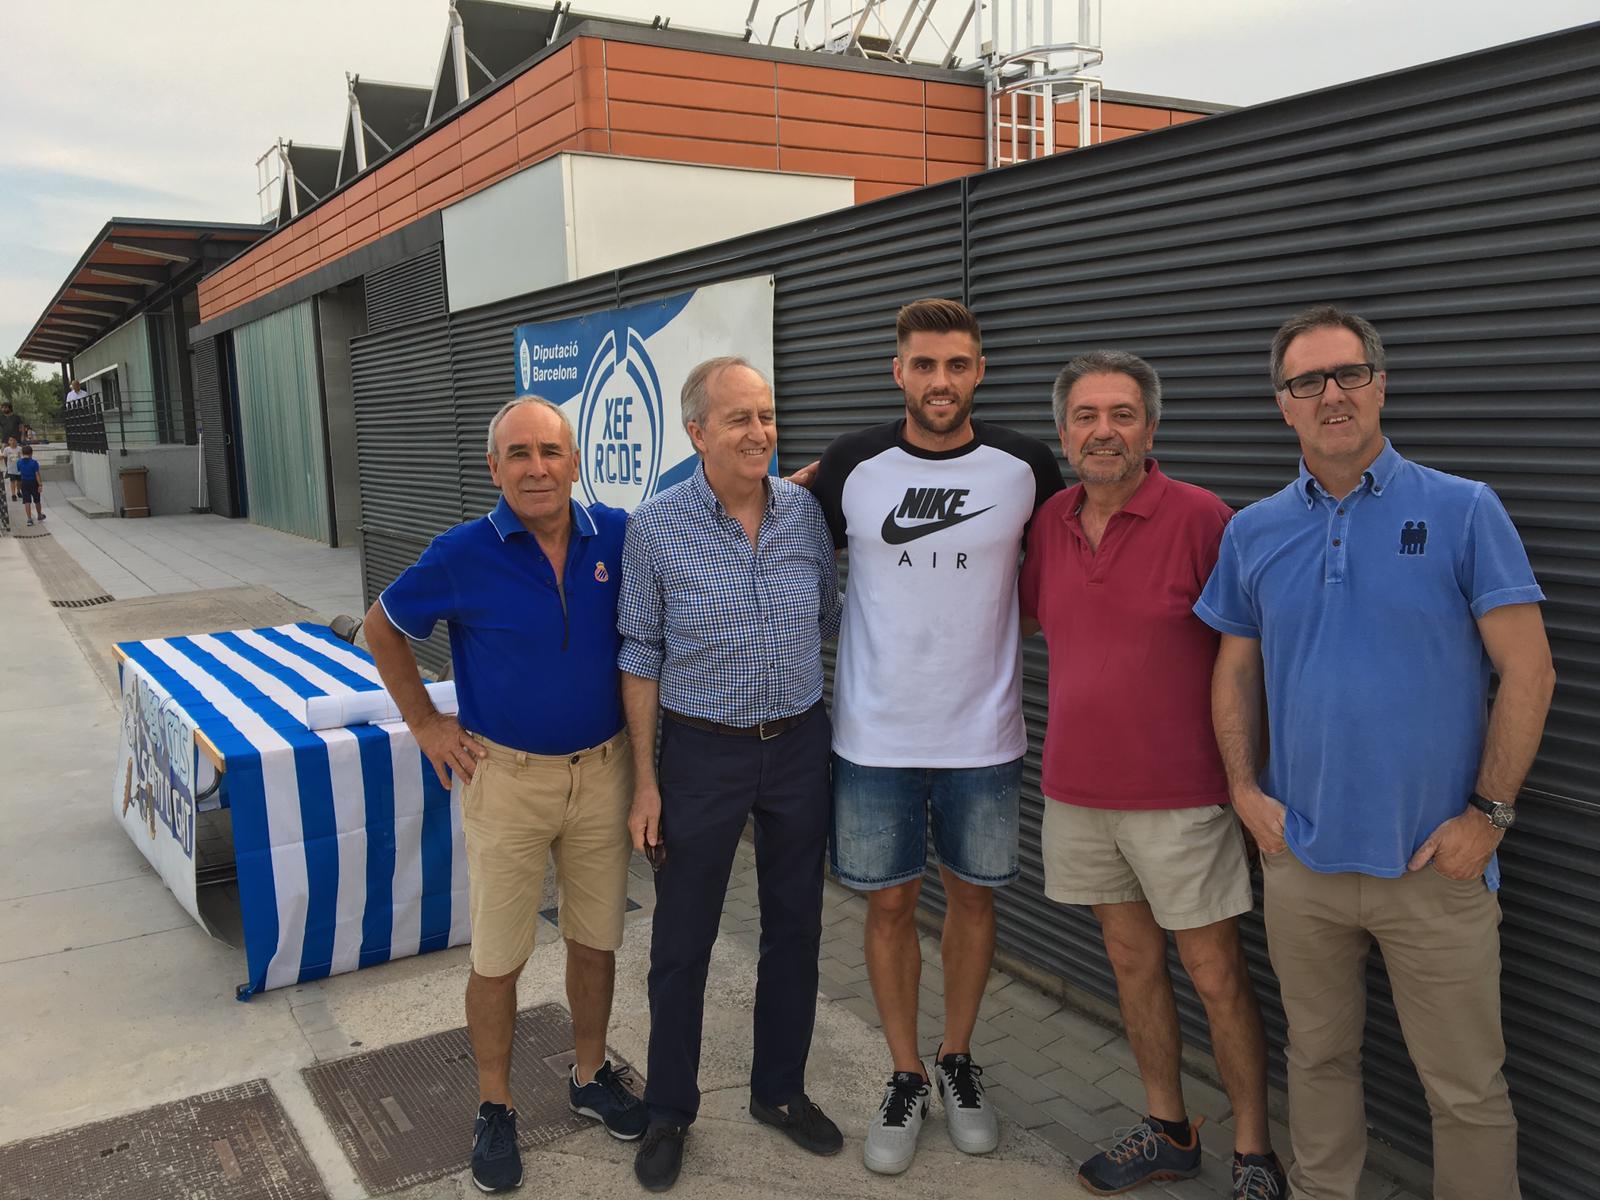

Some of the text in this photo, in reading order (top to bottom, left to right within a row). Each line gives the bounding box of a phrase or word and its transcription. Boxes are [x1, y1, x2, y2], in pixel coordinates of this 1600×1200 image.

[533, 341, 579, 363] Diputació
[533, 364, 578, 382] Barcelona
[602, 396, 633, 440] XEF
[594, 443, 642, 485] RCDE
[896, 487, 970, 520] NIKE
[898, 550, 967, 569] AIR
